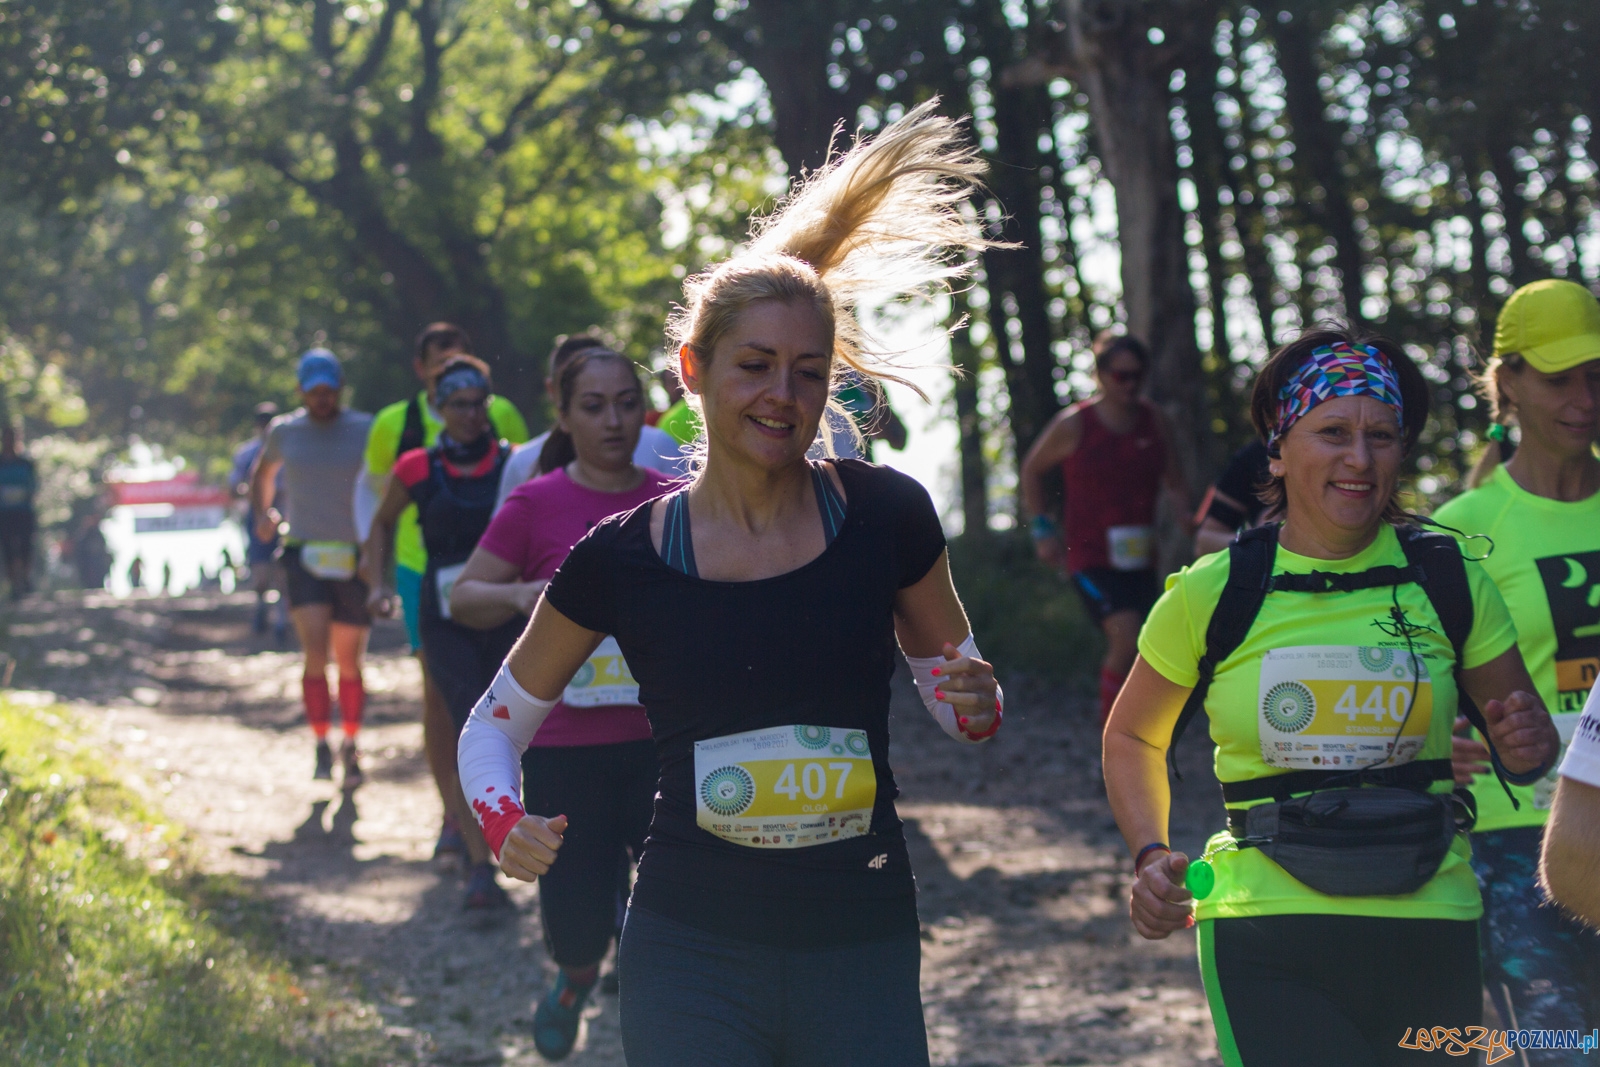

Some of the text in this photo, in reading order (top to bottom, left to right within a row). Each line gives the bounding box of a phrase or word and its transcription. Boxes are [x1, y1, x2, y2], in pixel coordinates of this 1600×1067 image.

[1334, 684, 1412, 722] 440
[774, 762, 853, 801] 407
[802, 803, 829, 813] OLGA
[867, 853, 888, 869] 4F
